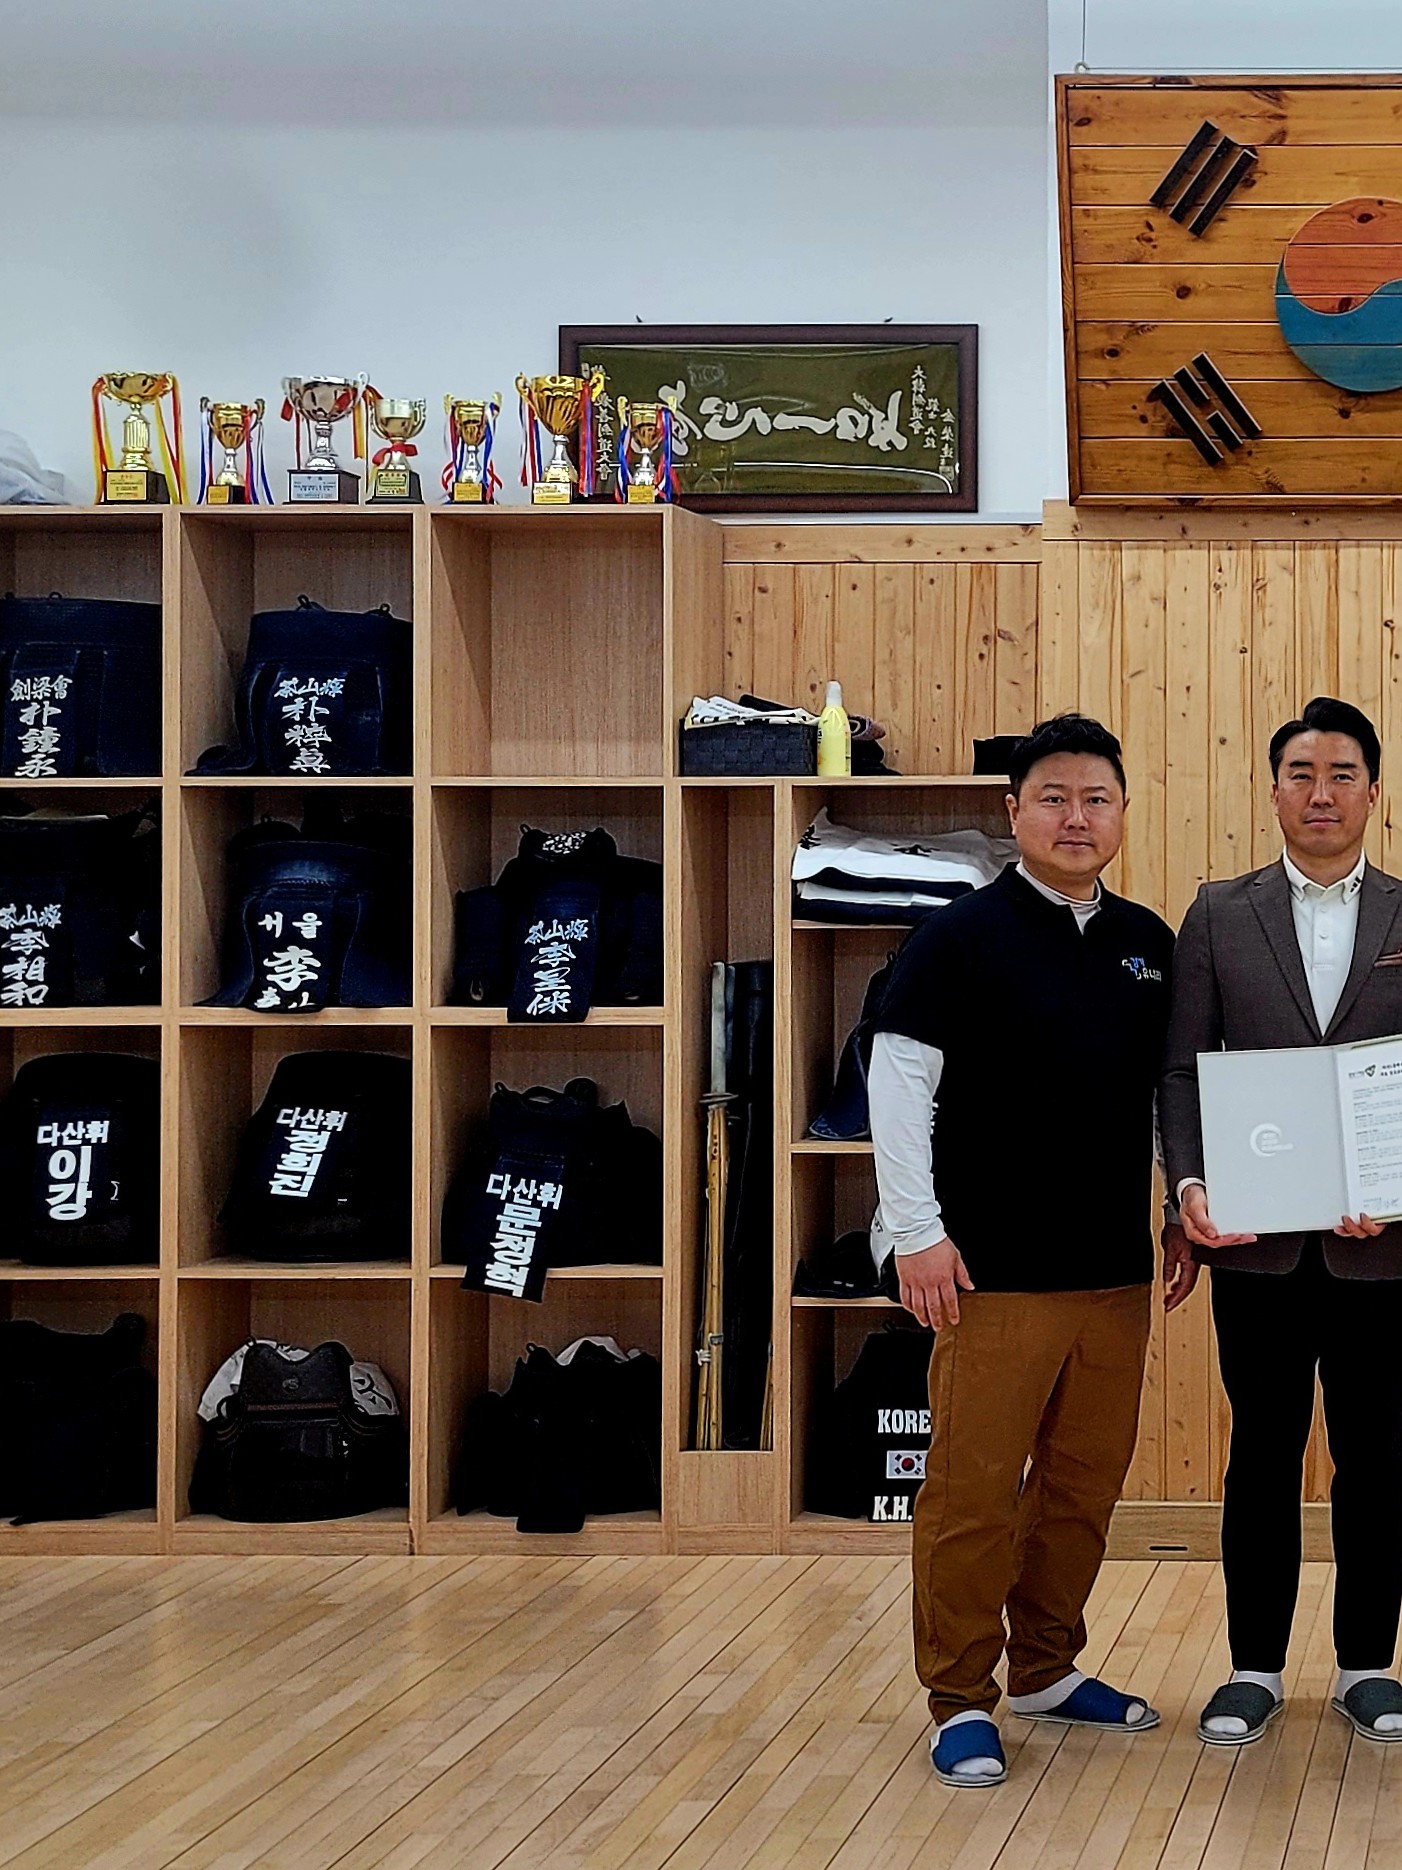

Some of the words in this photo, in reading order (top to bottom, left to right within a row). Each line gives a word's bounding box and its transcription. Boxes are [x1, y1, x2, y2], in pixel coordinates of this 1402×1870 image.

[257, 911, 323, 939] 서울
[36, 1120, 110, 1149] 다산휘
[276, 1106, 348, 1138] 다산휘
[45, 1144, 93, 1221] 이강
[268, 1132, 331, 1198] 정희진
[485, 1173, 564, 1211] 다산휘
[484, 1203, 542, 1297] 문정혁
